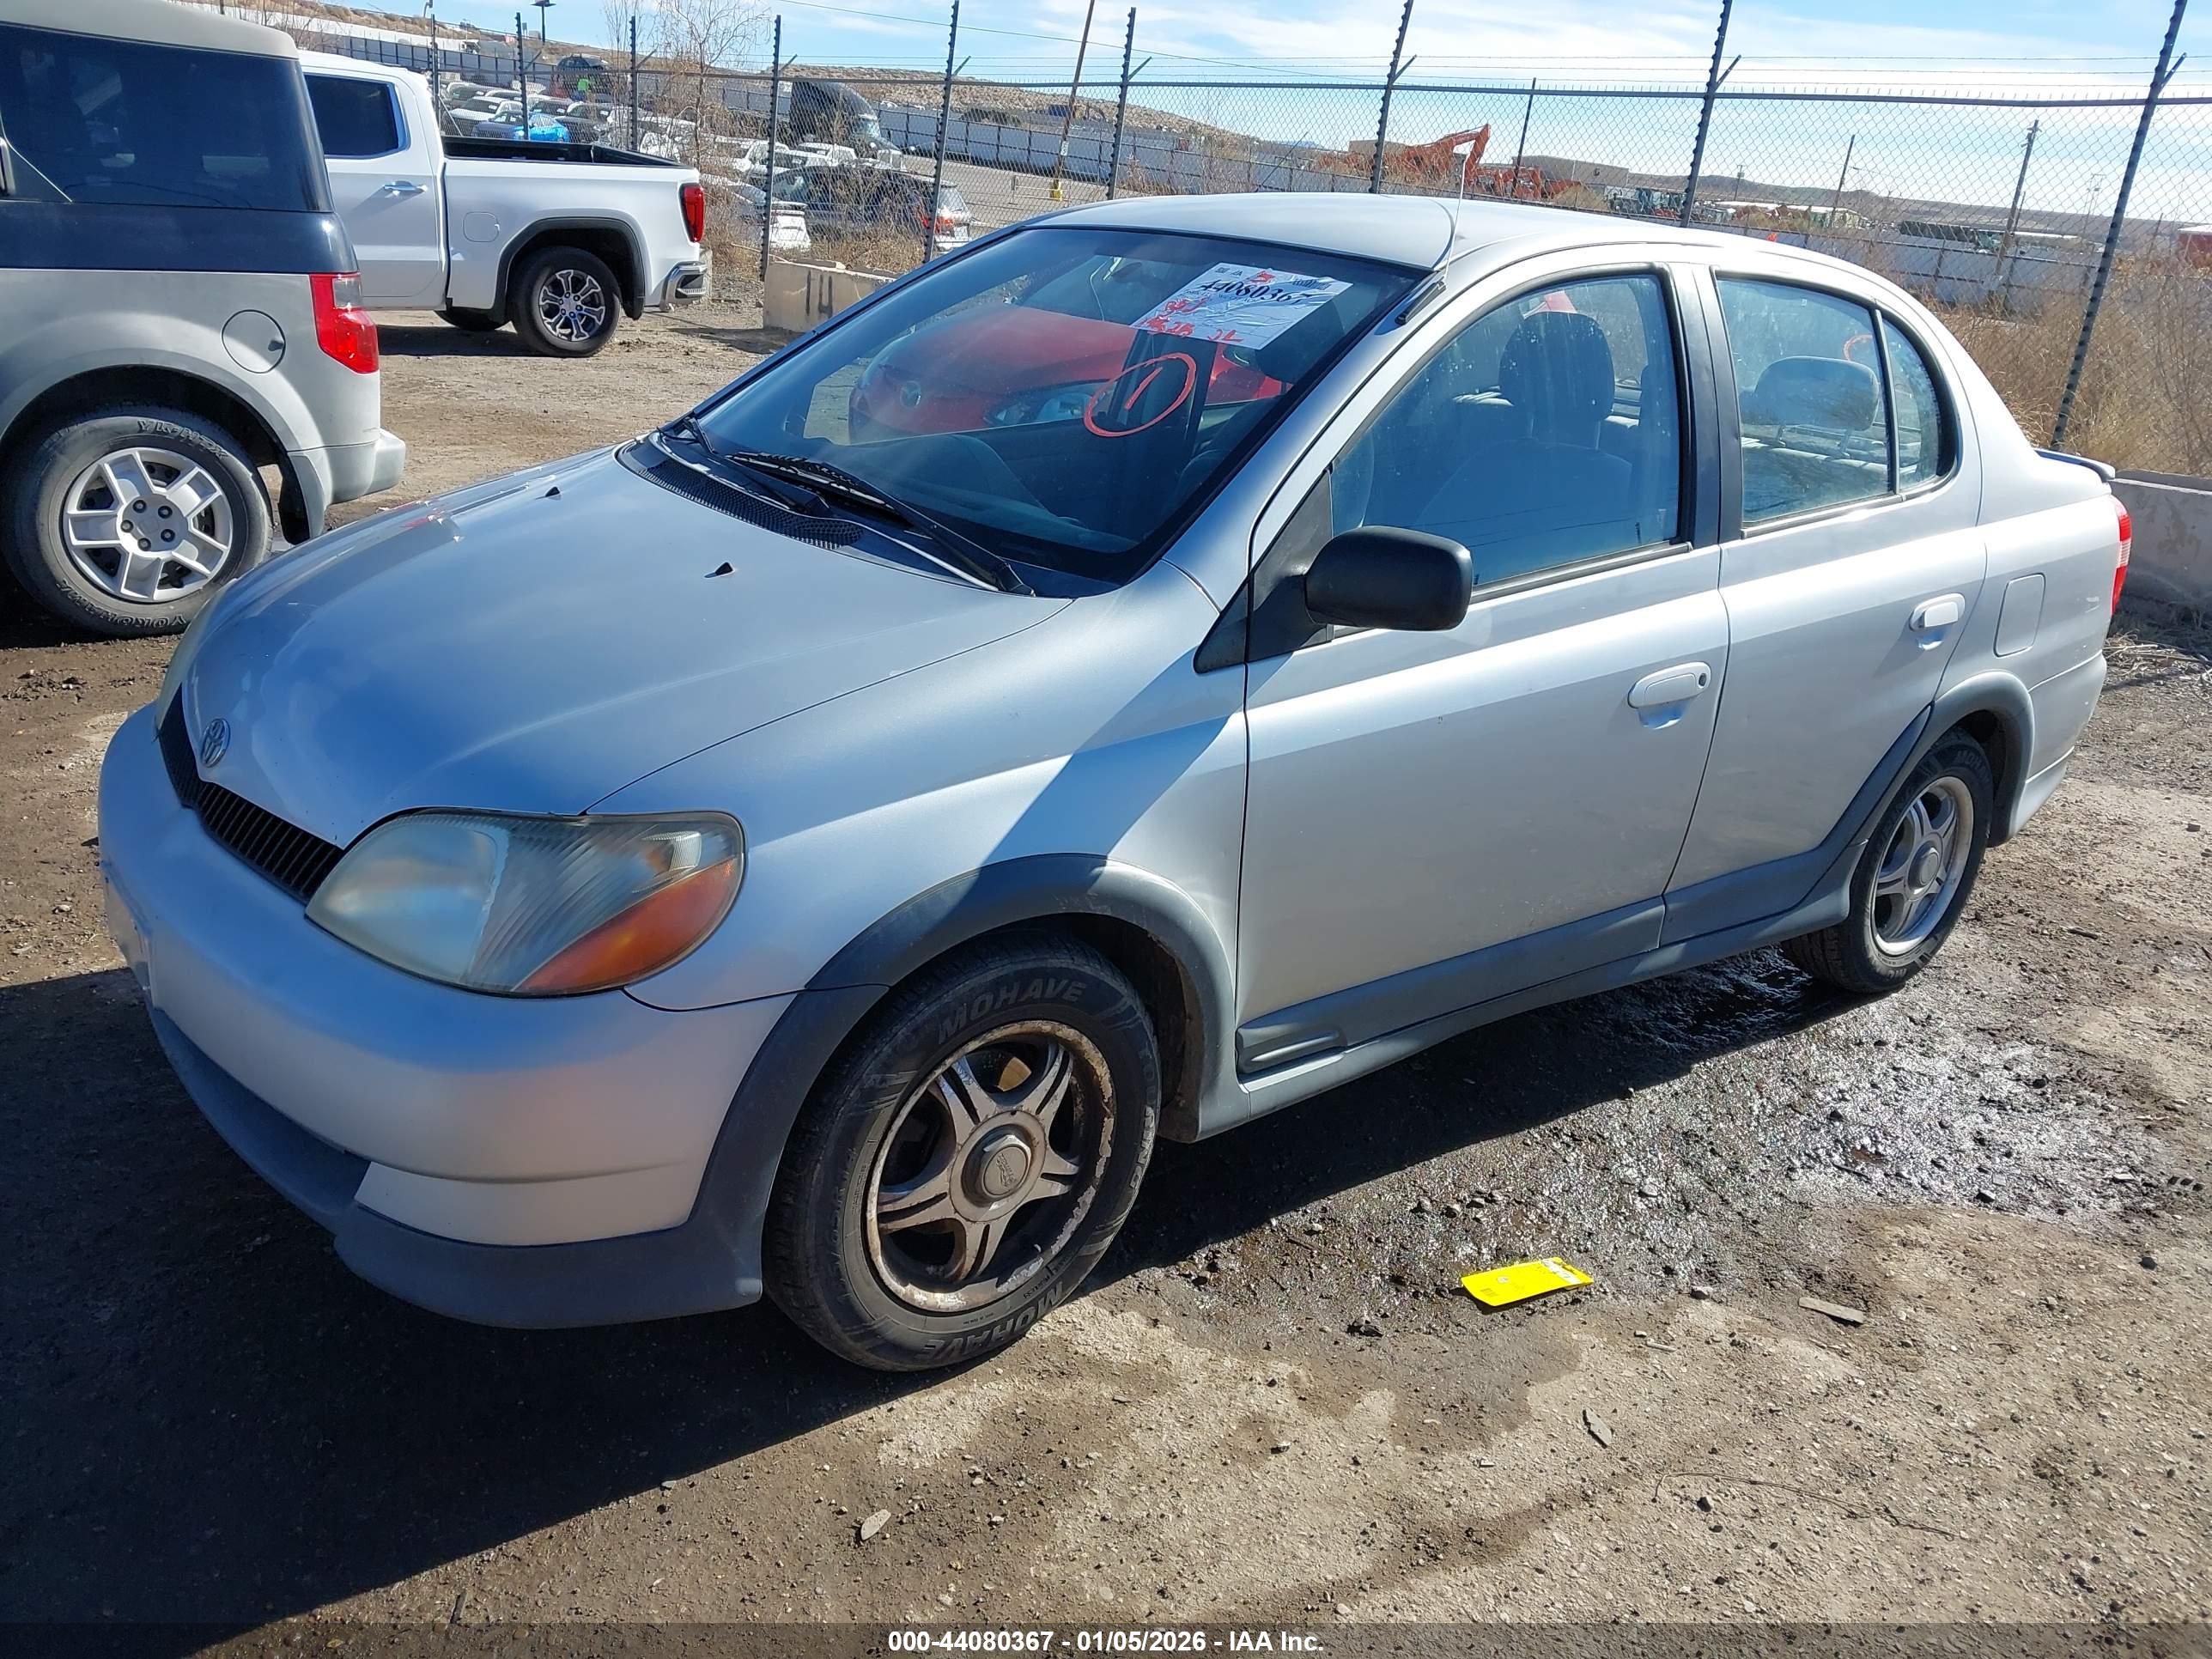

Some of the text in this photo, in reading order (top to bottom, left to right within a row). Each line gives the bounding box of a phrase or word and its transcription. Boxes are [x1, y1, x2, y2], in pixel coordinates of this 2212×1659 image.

[56, 578, 186, 629] YOKOHAMA
[938, 978, 1087, 1045] MOHAVE
[914, 1280, 1064, 1359] MOHAVE
